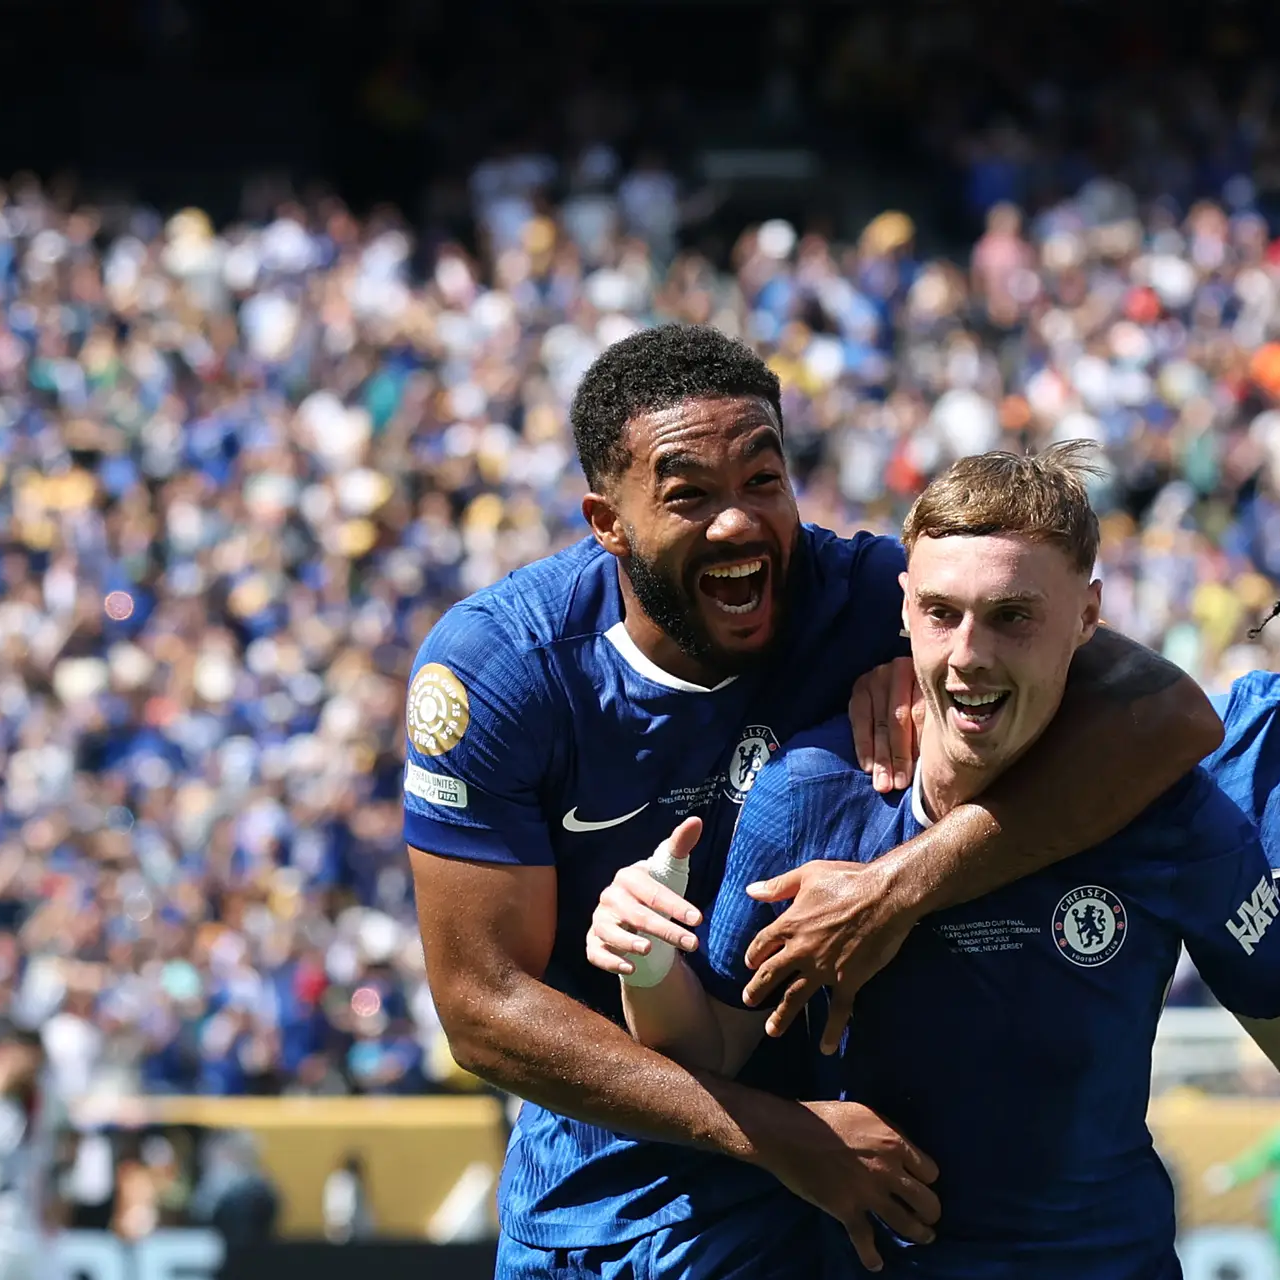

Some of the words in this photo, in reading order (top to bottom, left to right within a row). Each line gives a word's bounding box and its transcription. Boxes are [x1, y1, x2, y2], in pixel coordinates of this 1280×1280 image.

[441, 679, 457, 699] CUP
[451, 703, 461, 718] 25
[414, 729, 437, 750] FIFA
[440, 720, 458, 740] USA
[431, 775, 458, 791] UNITES
[1060, 888, 1107, 912] CHELSEA
[1225, 874, 1272, 940] LIVE
[965, 921, 991, 930] WORLD
[991, 920, 1006, 928] CUP
[1238, 885, 1280, 956] NAT
[989, 926, 1041, 936] SAINT-GERMAIN
[982, 944, 999, 952] NEW
[999, 942, 1024, 951] JERSEY
[1071, 952, 1103, 963] FOOTBALL
[1104, 940, 1119, 956] CLUB
